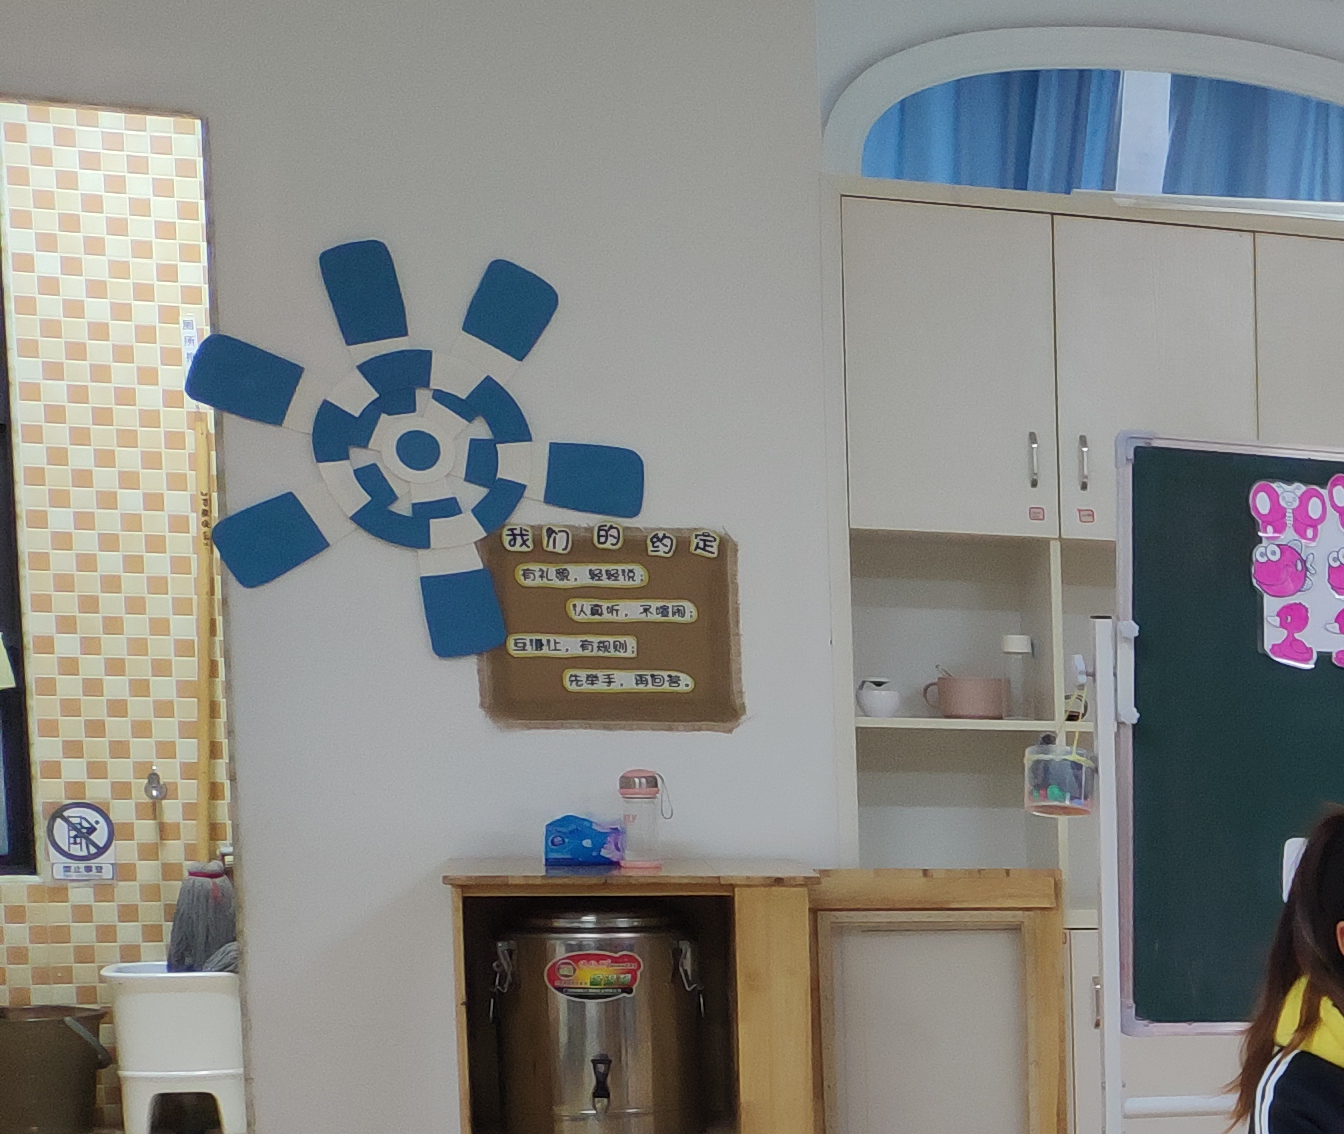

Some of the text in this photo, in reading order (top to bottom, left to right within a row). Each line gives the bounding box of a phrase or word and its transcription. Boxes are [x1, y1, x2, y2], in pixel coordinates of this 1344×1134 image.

[505, 524, 718, 554] 我们的约定
